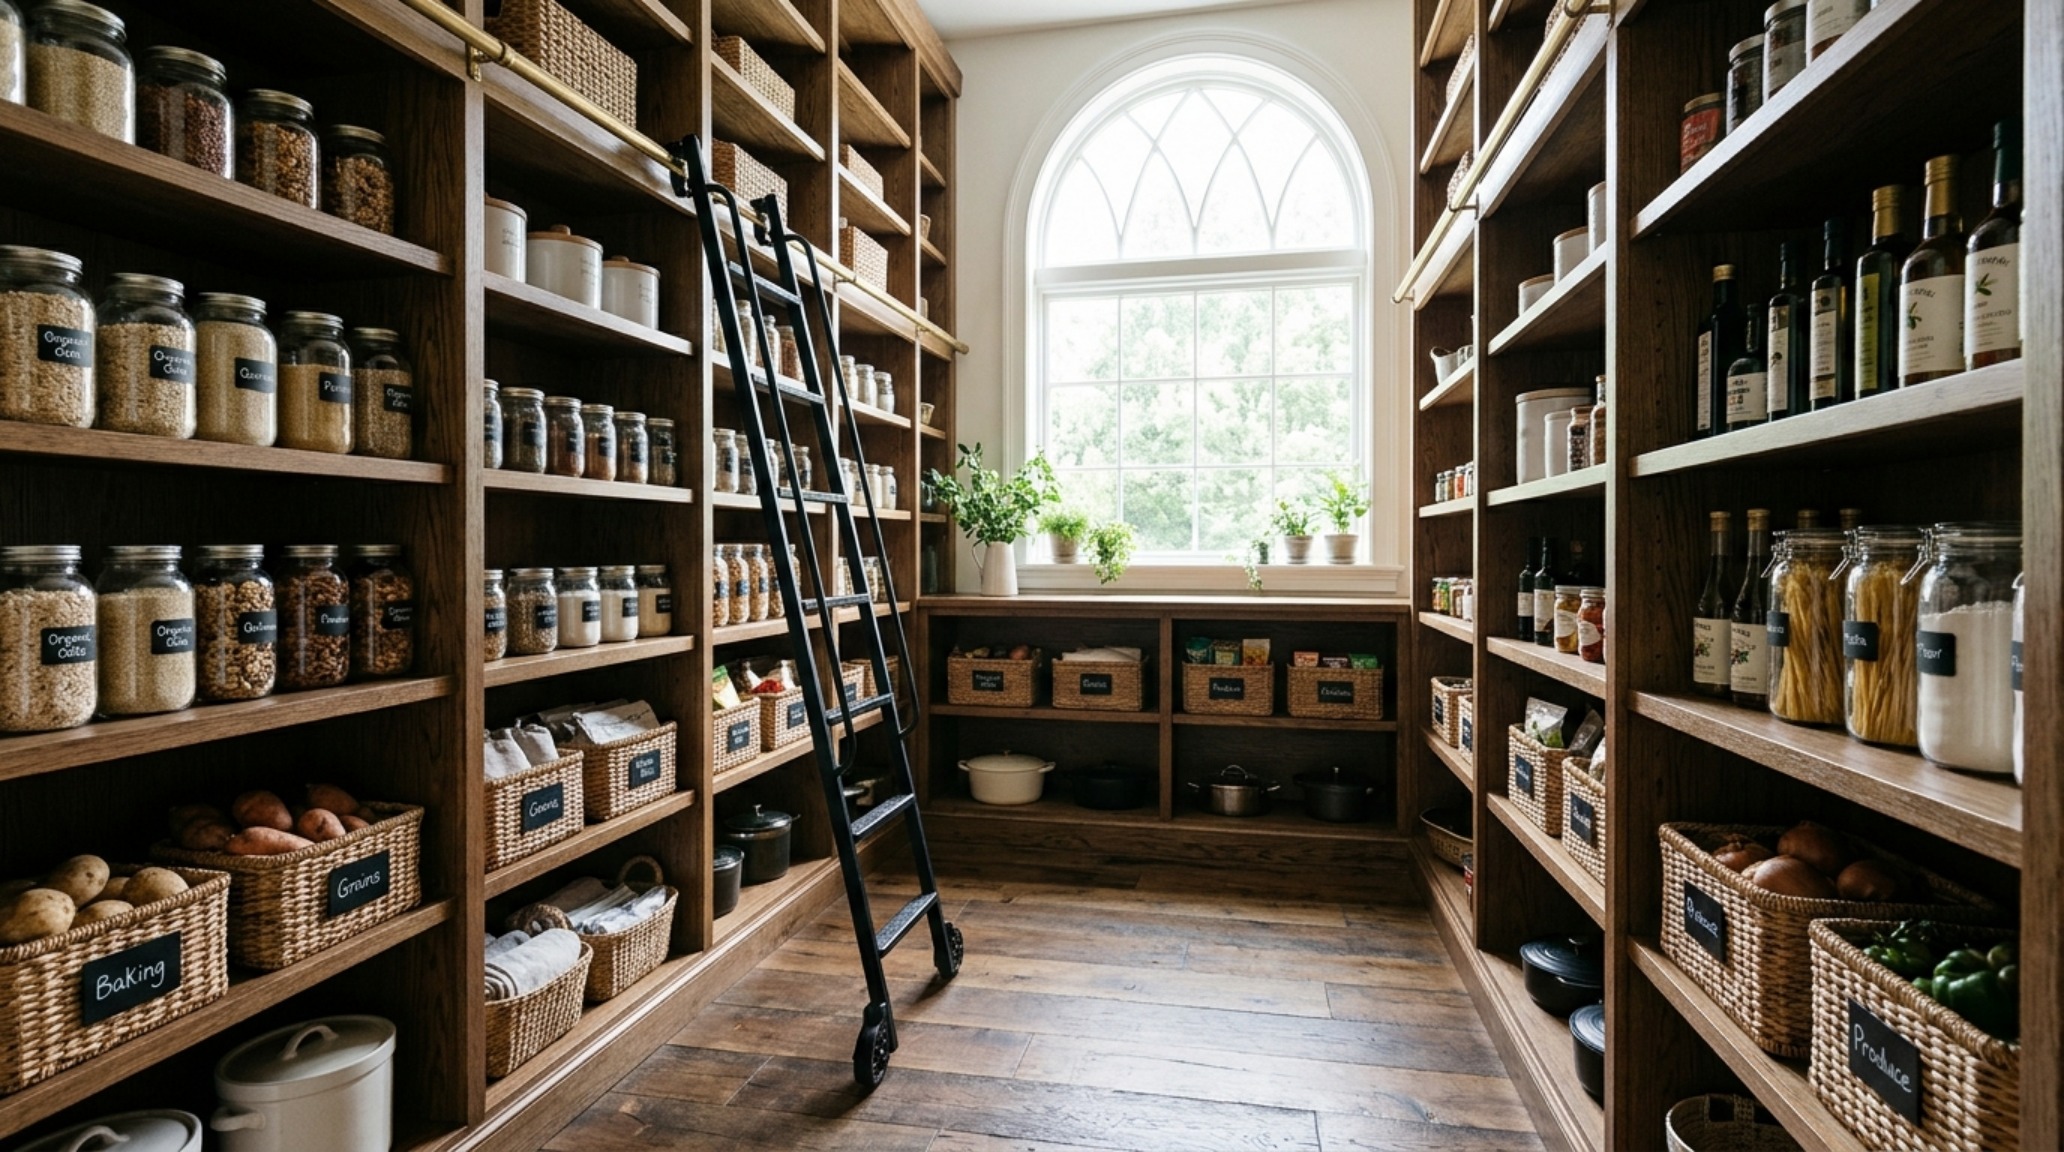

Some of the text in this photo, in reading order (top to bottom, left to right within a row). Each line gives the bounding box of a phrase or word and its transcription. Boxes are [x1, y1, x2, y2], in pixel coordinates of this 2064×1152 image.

[337, 870, 381, 899] Grains
[96, 959, 165, 1001] Baking
[1854, 1023, 1912, 1093] Produce
